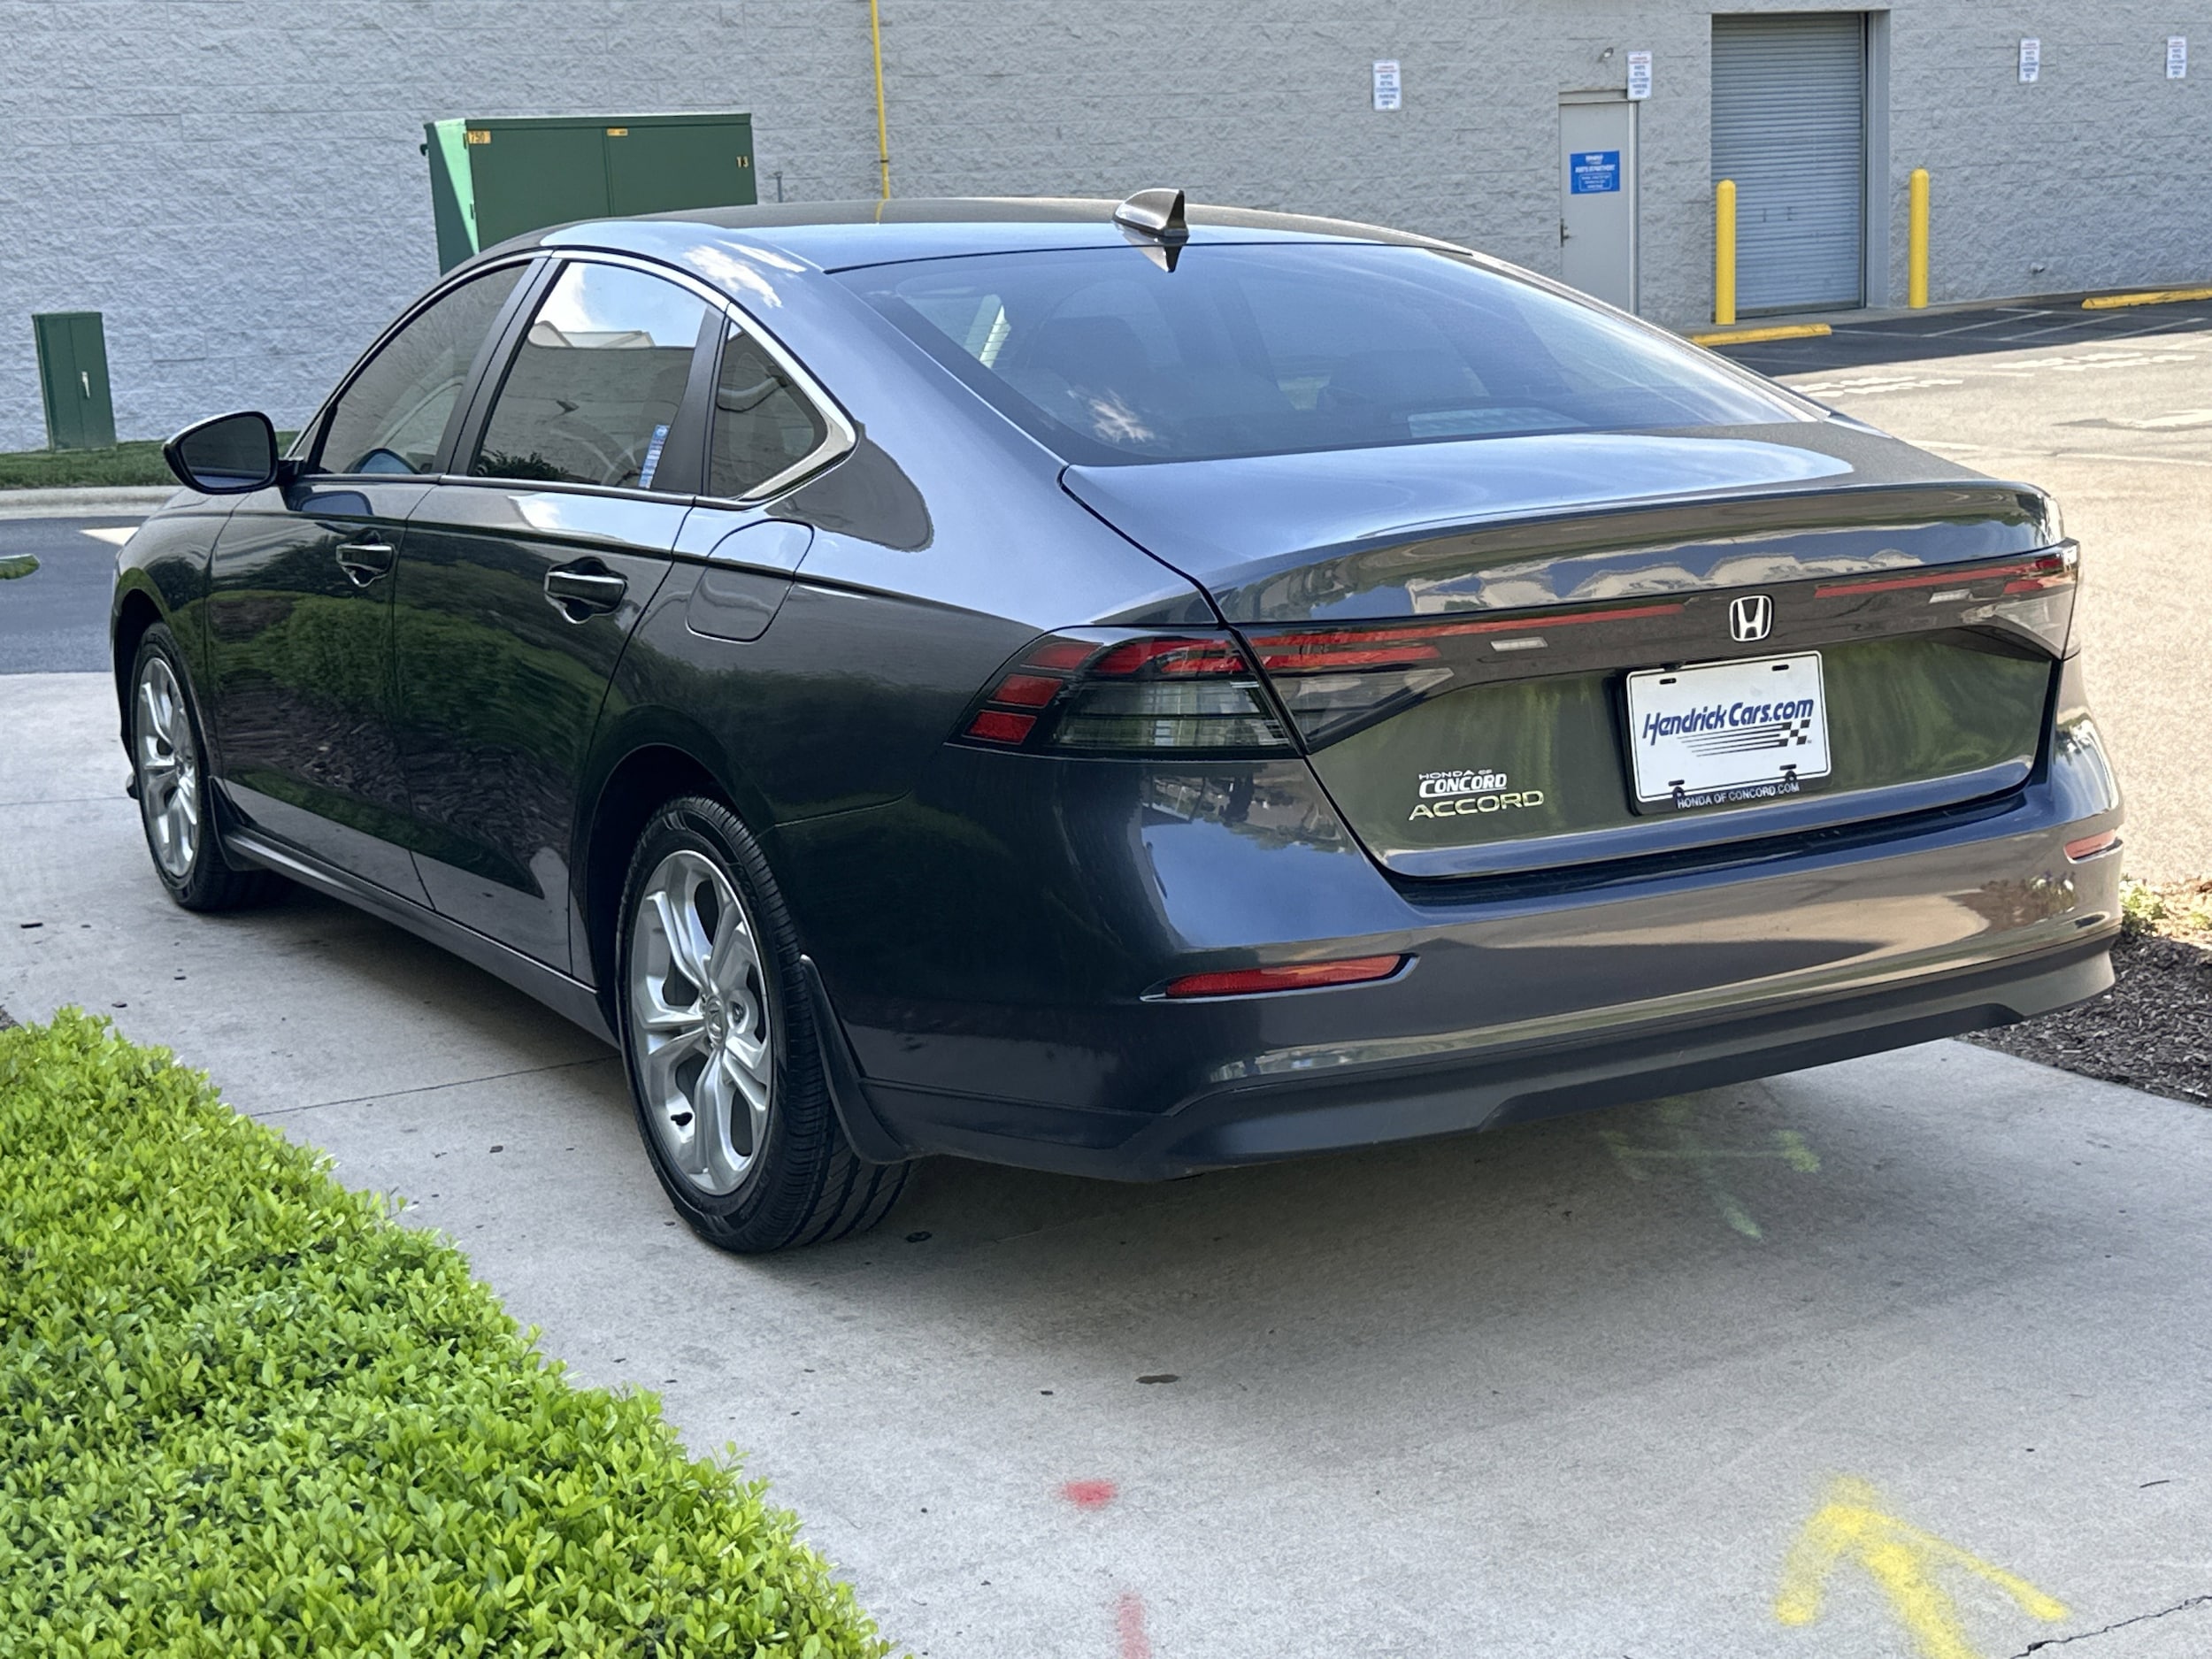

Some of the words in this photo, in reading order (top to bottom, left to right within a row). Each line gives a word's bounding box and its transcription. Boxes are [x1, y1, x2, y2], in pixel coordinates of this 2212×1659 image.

[1418, 769, 1475, 780] HONDA
[1418, 772, 1508, 798] CONCORD
[1408, 789, 1545, 821] ACCORD
[1677, 795, 1713, 809] HONDA
[1713, 792, 1727, 803] OF
